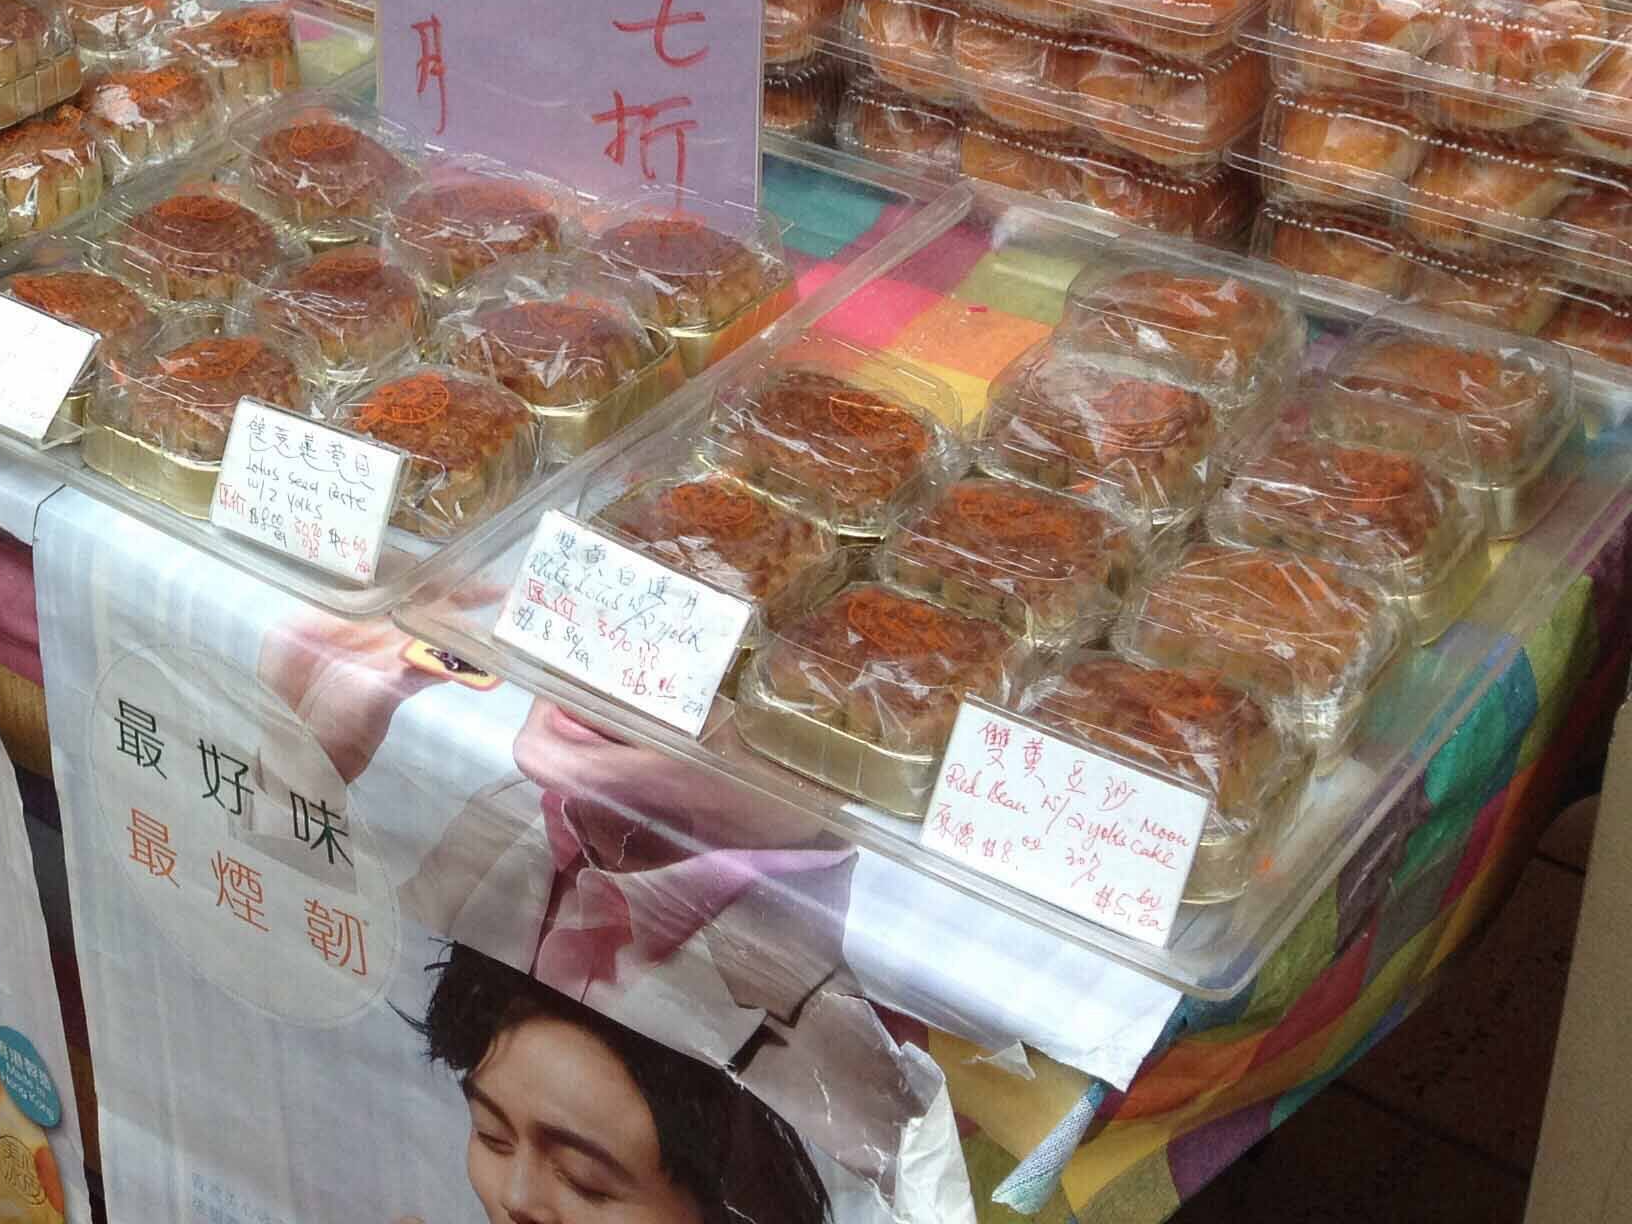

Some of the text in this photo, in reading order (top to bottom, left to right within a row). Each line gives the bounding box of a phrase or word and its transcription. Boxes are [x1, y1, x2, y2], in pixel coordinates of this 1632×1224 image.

[114, 698, 353, 866] 最好味
[945, 763, 983, 798] Red
[127, 808, 369, 977] 最煙韌
